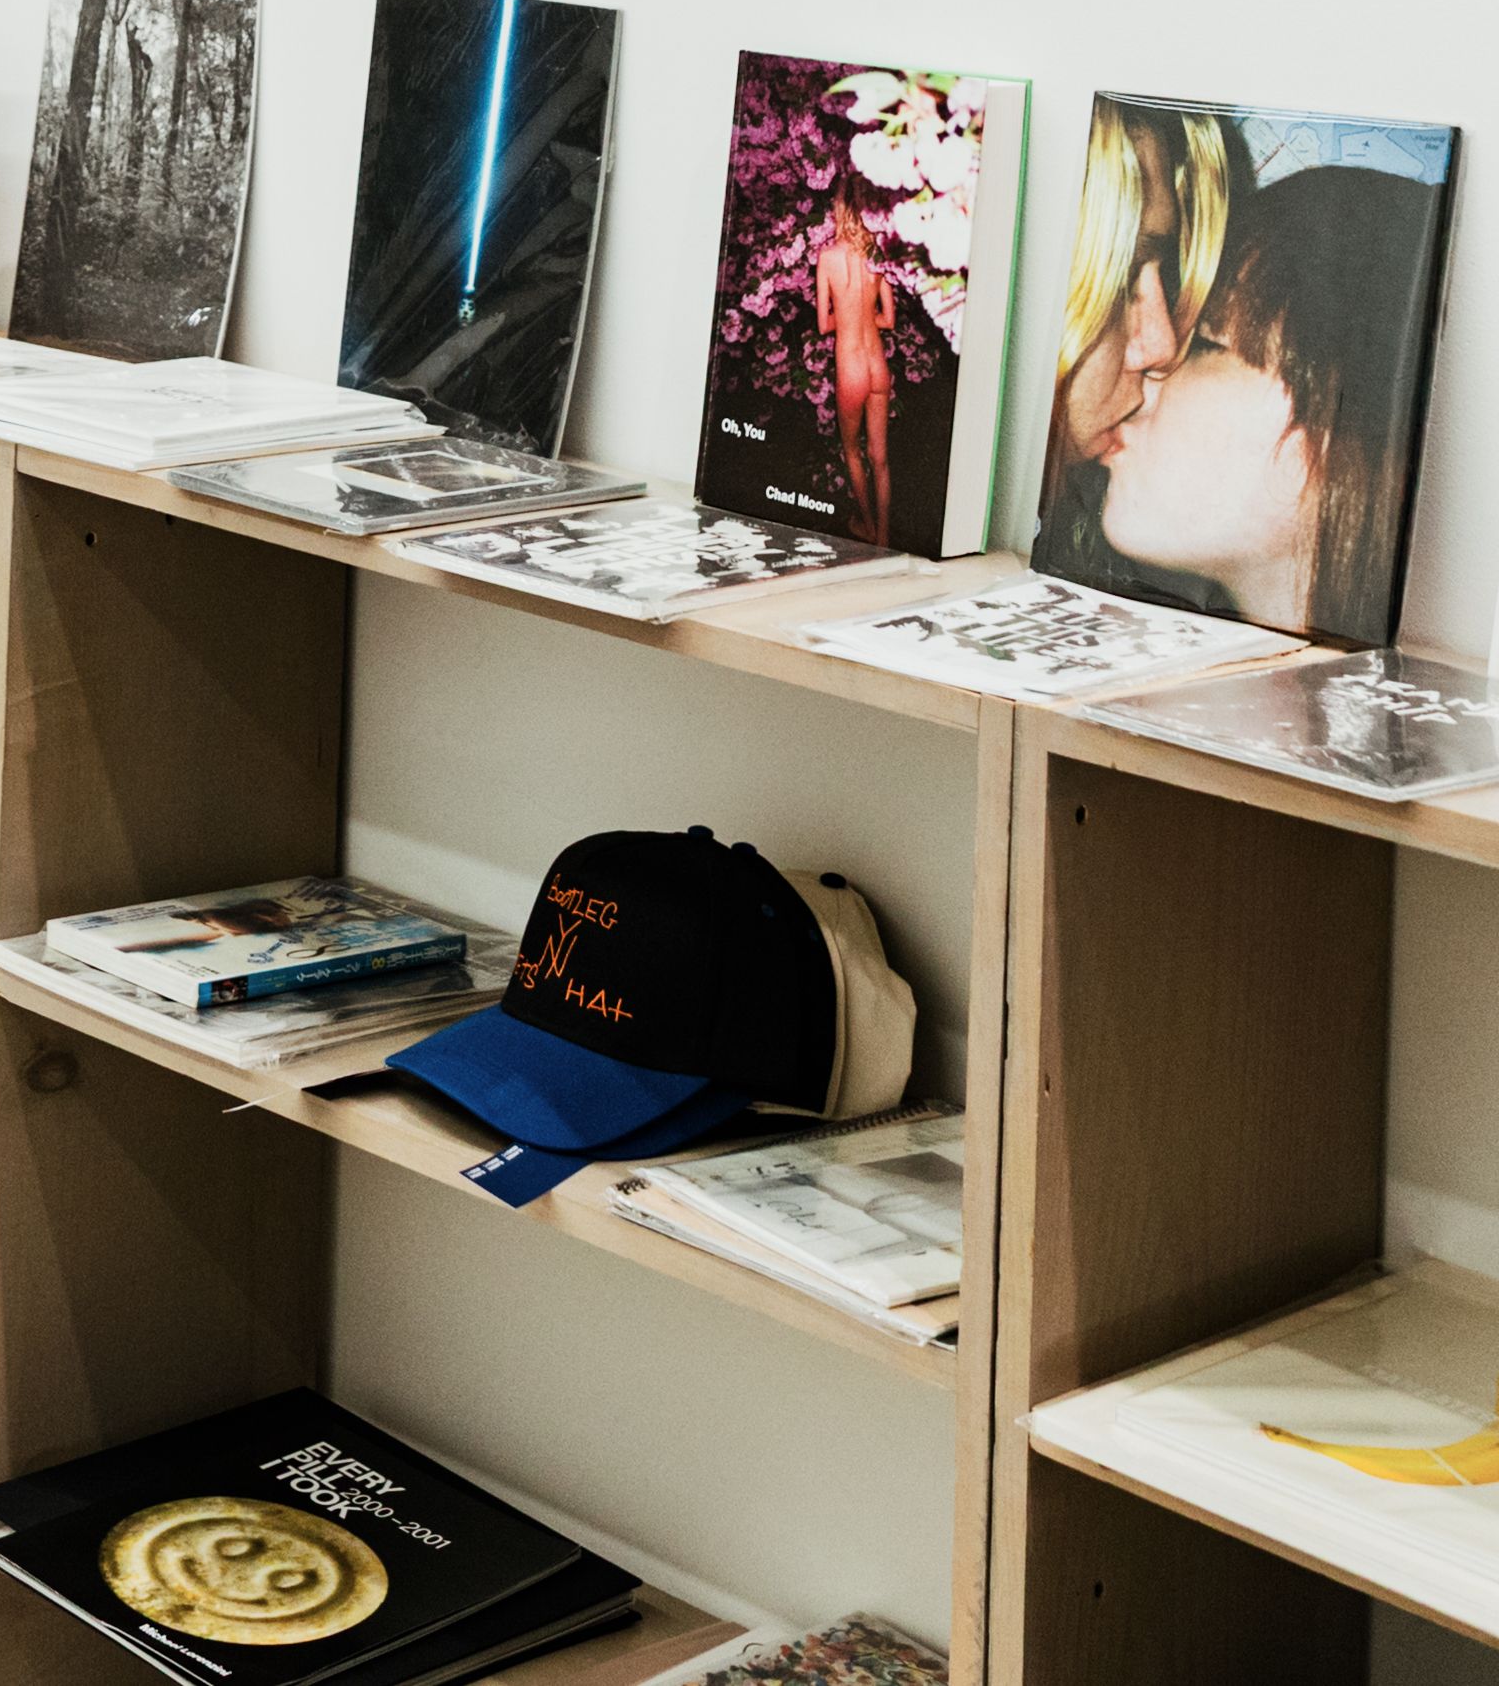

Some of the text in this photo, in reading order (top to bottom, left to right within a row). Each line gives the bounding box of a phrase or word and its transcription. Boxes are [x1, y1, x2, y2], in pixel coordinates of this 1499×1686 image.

[721, 417, 766, 442] Oh, You
[765, 485, 835, 515] Chad Moore
[948, 621, 1075, 656] LIFE
[991, 612, 1101, 648] THIS
[283, 1450, 340, 1491] PILL
[305, 1441, 406, 1496] EVERY
[259, 1458, 284, 1470] I
[276, 1466, 364, 1520] TOOK
